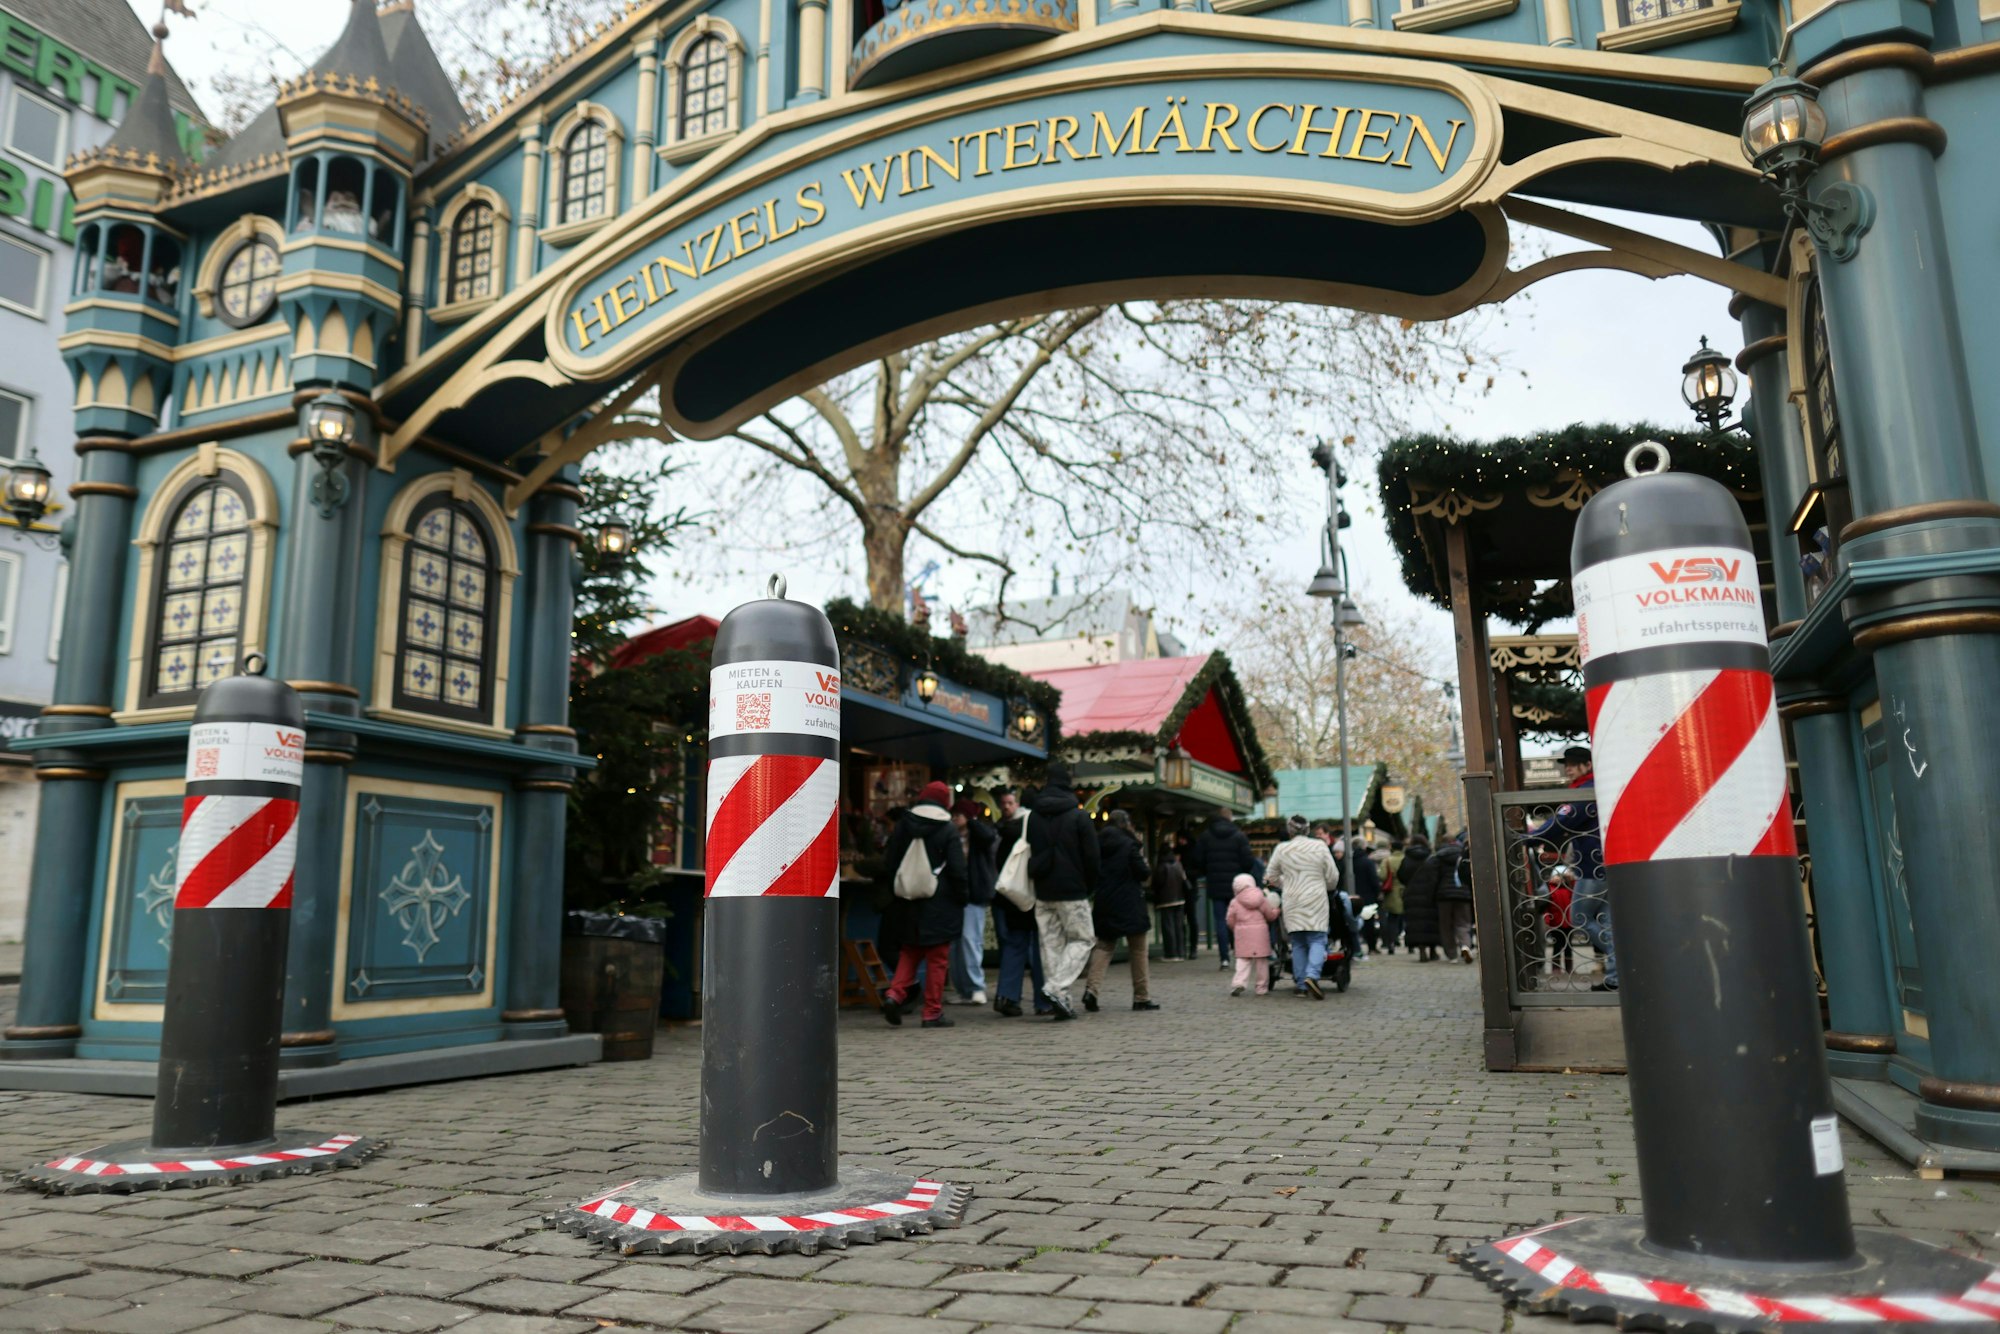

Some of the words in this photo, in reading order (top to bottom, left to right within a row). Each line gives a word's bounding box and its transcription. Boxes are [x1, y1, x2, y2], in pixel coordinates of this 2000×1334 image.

[571, 181, 826, 351] HEINZELS
[841, 96, 1466, 209] WINTERMÄRCHEN
[1649, 557, 1741, 585] VSV
[1636, 586, 1756, 608] VOLKMANN
[1640, 619, 1760, 637] zufahrtssperre.de
[729, 668, 770, 679] MIETEN
[774, 669, 781, 677] &
[815, 671, 839, 695] VS
[736, 679, 783, 690] KAUFEN
[276, 731, 304, 748] VS
